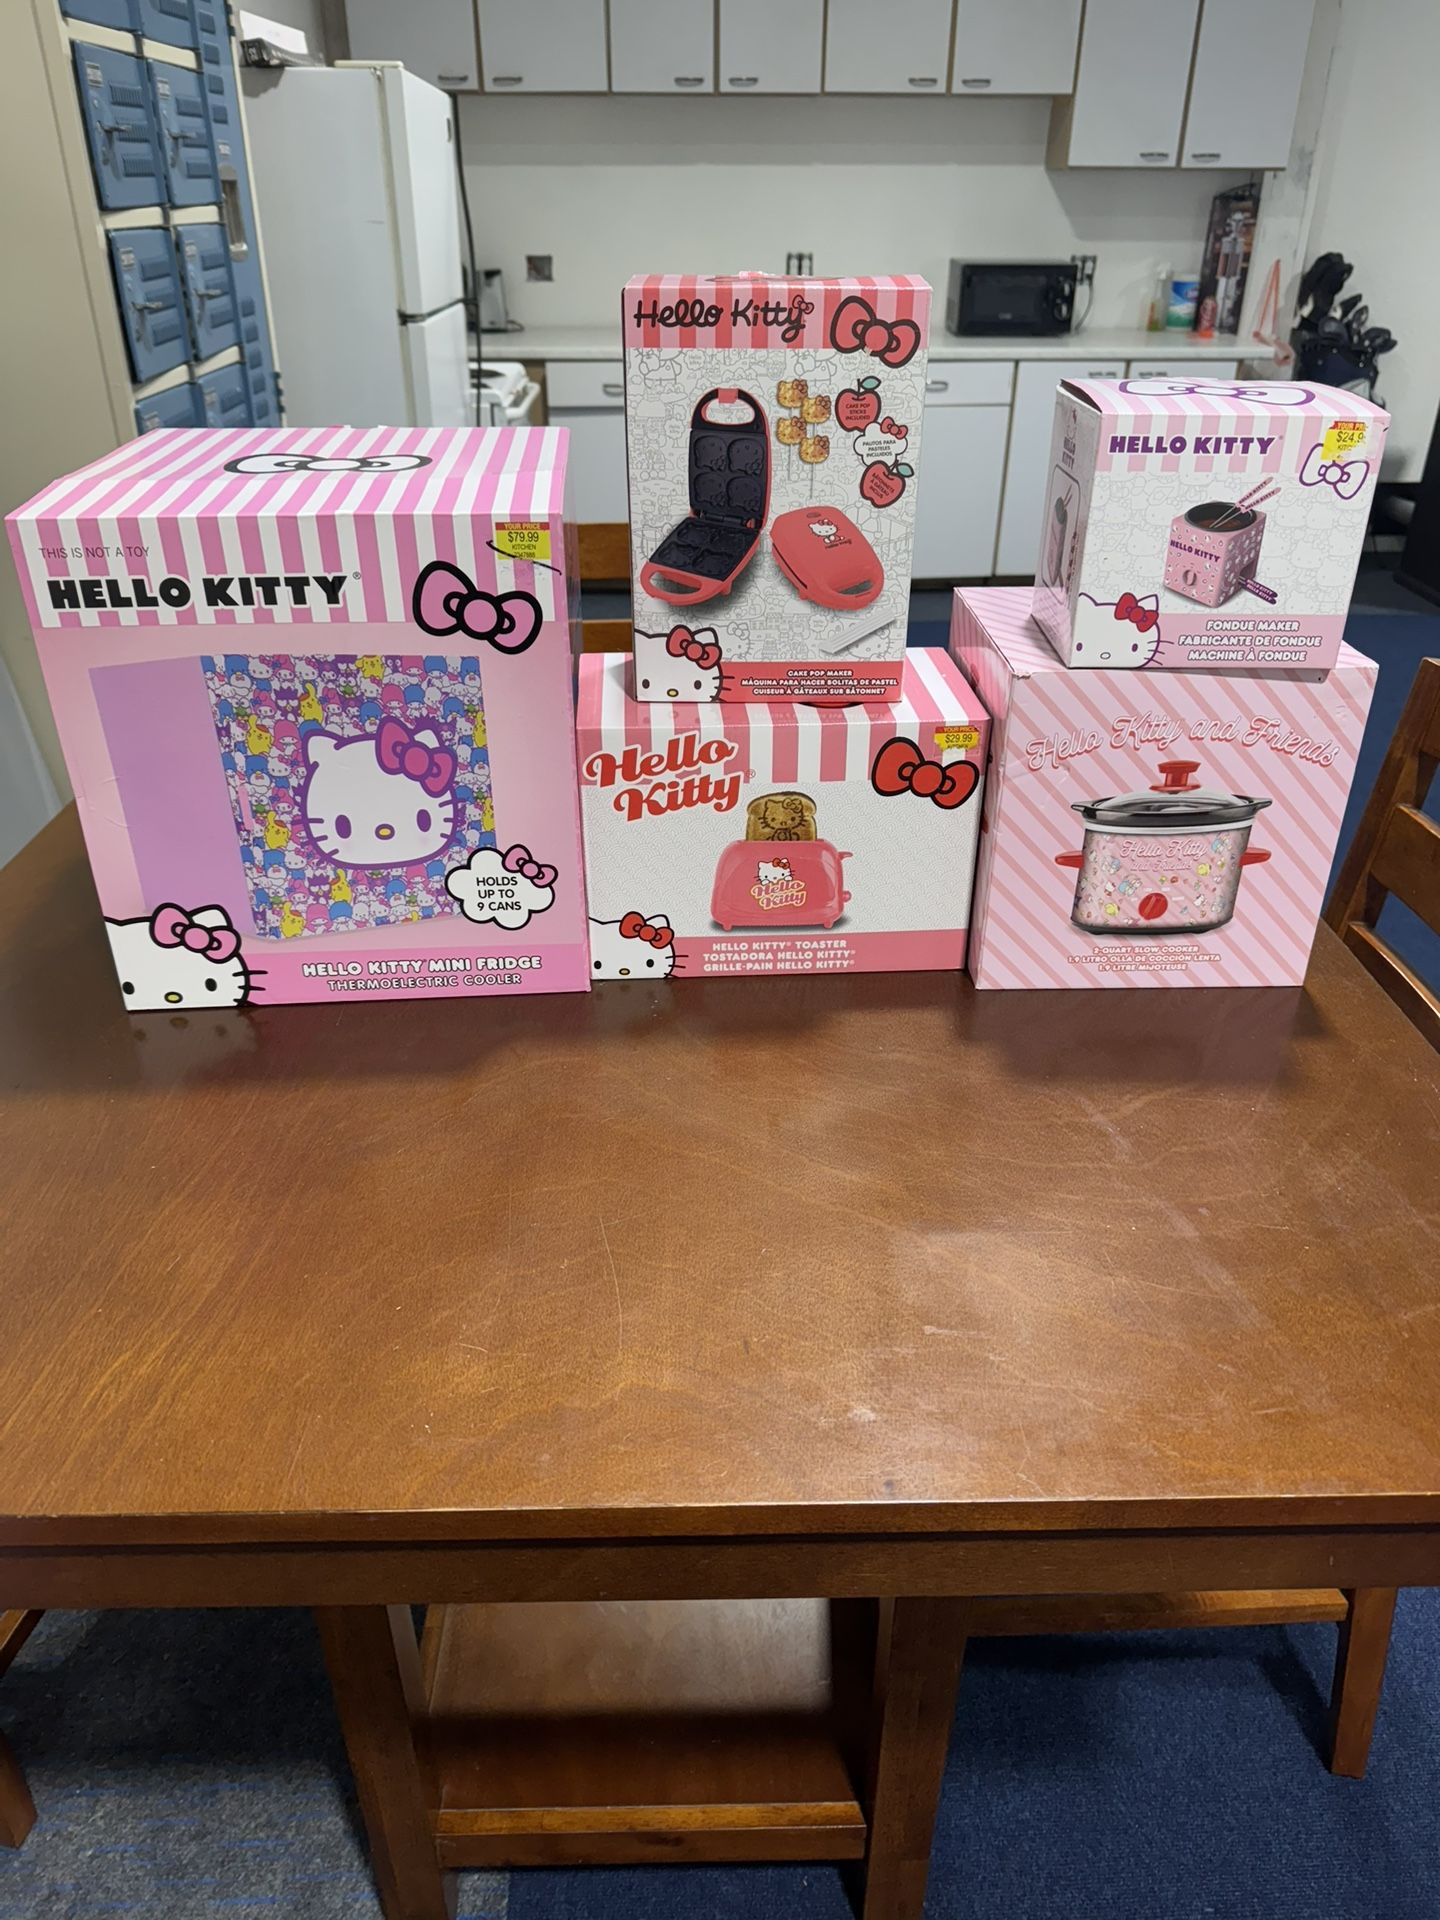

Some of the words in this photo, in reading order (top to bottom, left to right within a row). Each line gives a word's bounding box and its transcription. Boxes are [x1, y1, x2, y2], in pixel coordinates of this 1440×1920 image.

[634, 299, 724, 328] Hello
[731, 298, 806, 343] Kitty
[1109, 435, 1187, 454] HELLO
[1193, 436, 1275, 455] KITTY
[507, 531, 539, 543] $79.99
[39, 547, 68, 559] THIS
[71, 547, 83, 558] IS
[86, 547, 110, 558] NOT
[115, 547, 124, 557] A
[125, 546, 150, 557] TOY
[1169, 539, 1193, 554] HELLO
[1194, 548, 1221, 563] KITTY
[47, 577, 191, 609] HELLO
[1206, 620, 1255, 631] FONDUE
[1257, 620, 1300, 631] MAKER
[1178, 635, 1252, 646] FABRICANTE
[1254, 635, 1272, 646] DE
[1273, 636, 1322, 647] FONDUE
[1187, 649, 1244, 661] MACHINE
[1245, 647, 1255, 661] À
[1258, 651, 1307, 662] FONDUE
[787, 669, 808, 677] CAKE
[809, 669, 826, 677] POP
[826, 669, 853, 677] MAKER
[779, 678, 799, 686] PARA
[800, 678, 826, 686] HACER
[827, 678, 858, 686] BOLITAS
[871, 678, 899, 686] PASTEL
[752, 687, 785, 695] CUISEUR
[793, 685, 828, 695] GÂTEAUX
[829, 687, 844, 695] SUR
[845, 685, 886, 695] BÂTONNET
[945, 733, 973, 743] $29.99
[1026, 728, 1104, 771] Hello
[1109, 711, 1183, 751] Kitty
[1188, 716, 1242, 741] and
[1241, 715, 1340, 767] Friends
[585, 734, 737, 788] Hello
[1120, 839, 1163, 862] Hello
[1165, 839, 1208, 862] Kitty
[476, 876, 518, 886] HOLDS
[478, 889, 495, 899] UP
[498, 889, 515, 898] TO
[751, 880, 805, 899] Hello
[477, 902, 485, 911] 9
[488, 901, 522, 911] CANS
[759, 891, 807, 910] Kitty
[712, 942, 749, 951] HELLO
[795, 940, 847, 949] TOASTER
[1134, 946, 1160, 954] SLOW
[1162, 945, 1200, 953] COOKER
[703, 952, 774, 961] TOSTADORA
[777, 950, 813, 960] HELLO
[1082, 955, 1108, 963] LITRO
[1148, 953, 1192, 962] COCCIÓN
[302, 962, 363, 977] HELLO
[428, 958, 472, 972] MINI
[476, 955, 542, 971] FRIDGE
[703, 962, 773, 972] GRILLE-PAIN
[777, 961, 812, 970] HELLO
[1138, 963, 1187, 971] MIJOTEUSE
[327, 976, 458, 991] THERMOELECTRIC
[463, 973, 522, 986] COOLER
